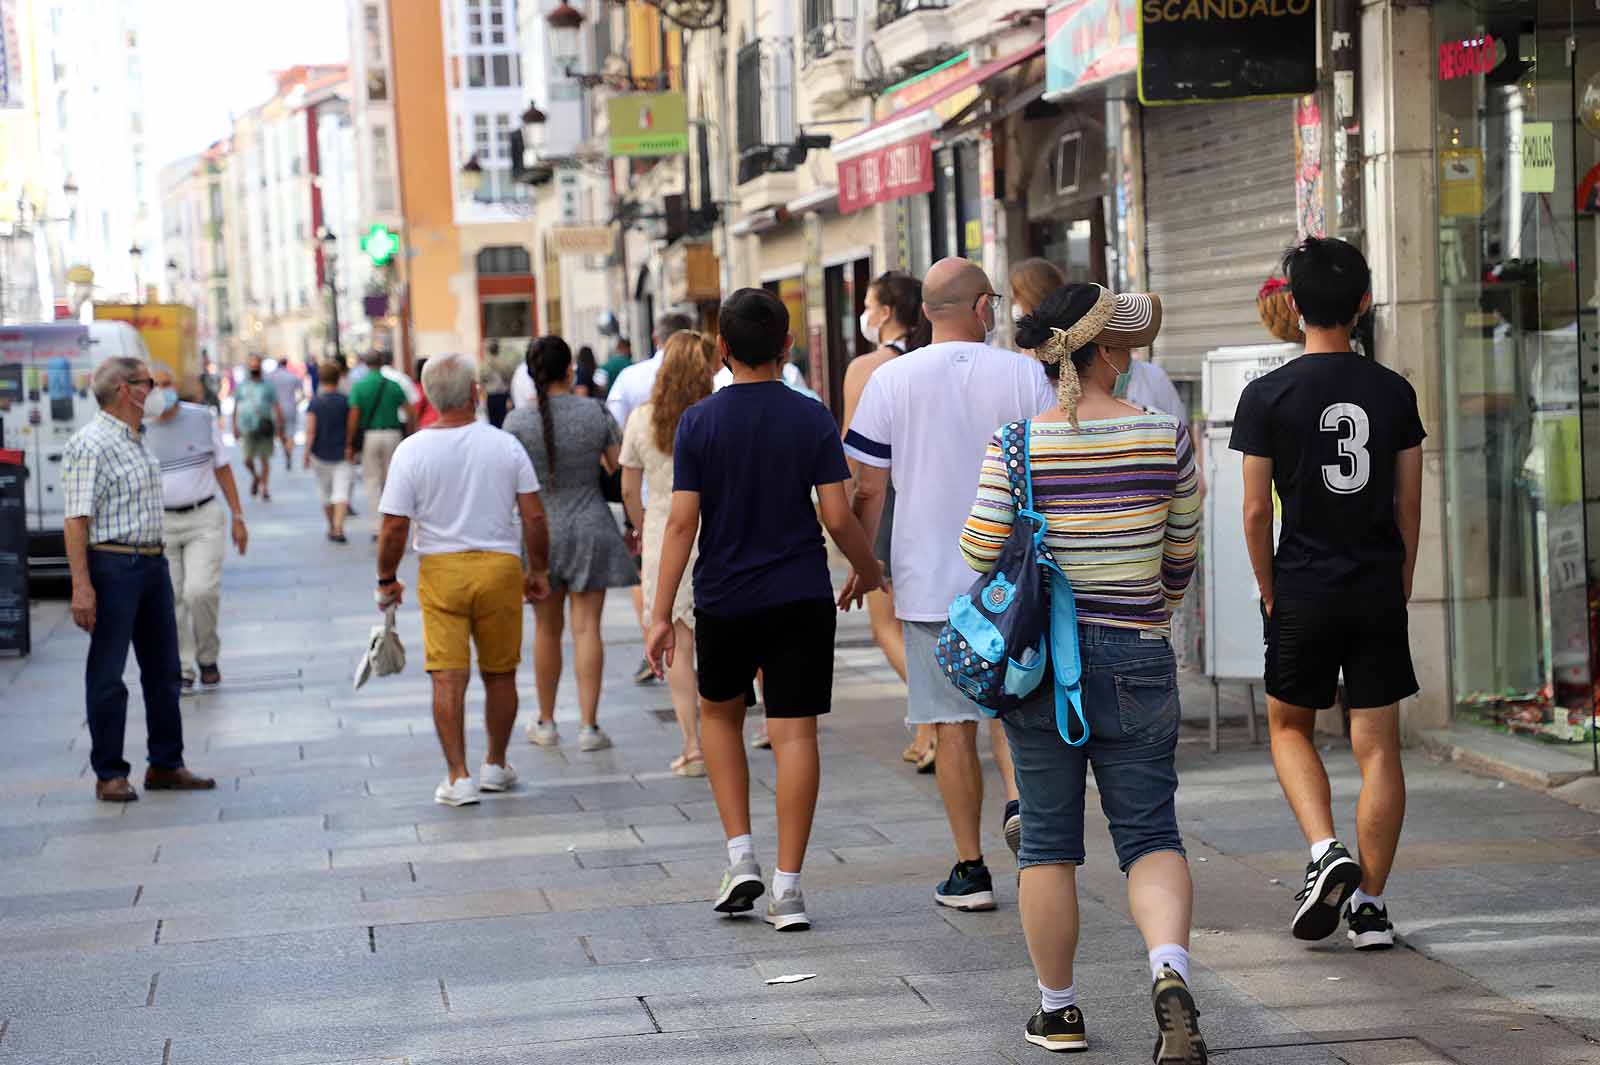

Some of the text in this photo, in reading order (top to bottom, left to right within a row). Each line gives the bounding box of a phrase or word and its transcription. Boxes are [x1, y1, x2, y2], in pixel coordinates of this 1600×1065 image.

[1143, 0, 1310, 23] SCANDALO
[1439, 33, 1495, 80] REGALO
[1320, 402, 1370, 494] 3
